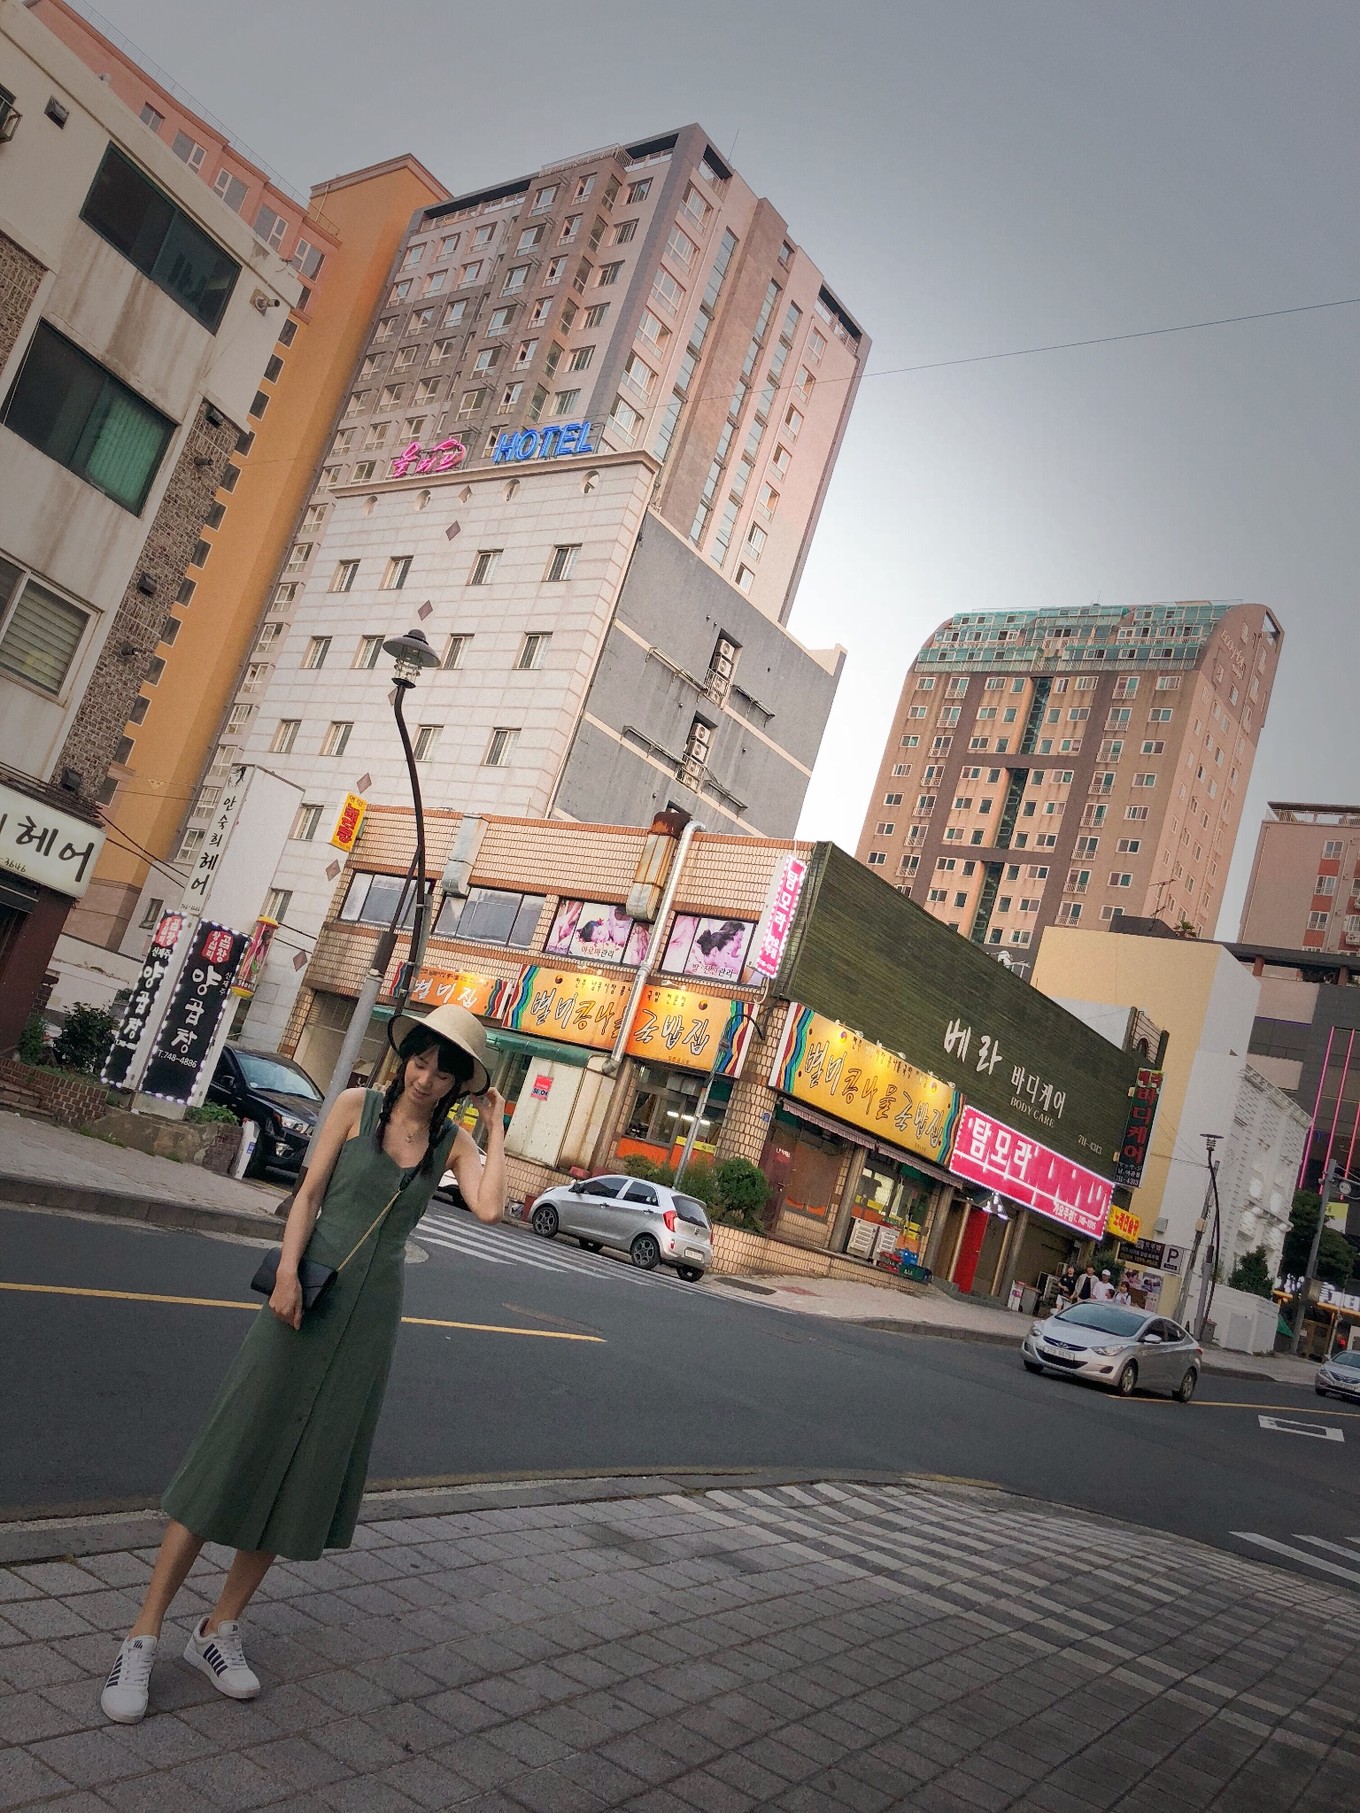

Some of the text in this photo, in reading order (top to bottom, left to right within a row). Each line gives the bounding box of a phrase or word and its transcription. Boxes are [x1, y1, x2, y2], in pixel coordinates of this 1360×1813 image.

[492, 421, 593, 464] HOTEL
[171, 965, 222, 1055] 양곱창
[943, 1018, 1066, 1119] 베라 바디케어
[1010, 1096, 1055, 1128] BODY CARE
[1167, 1248, 1179, 1262] P
